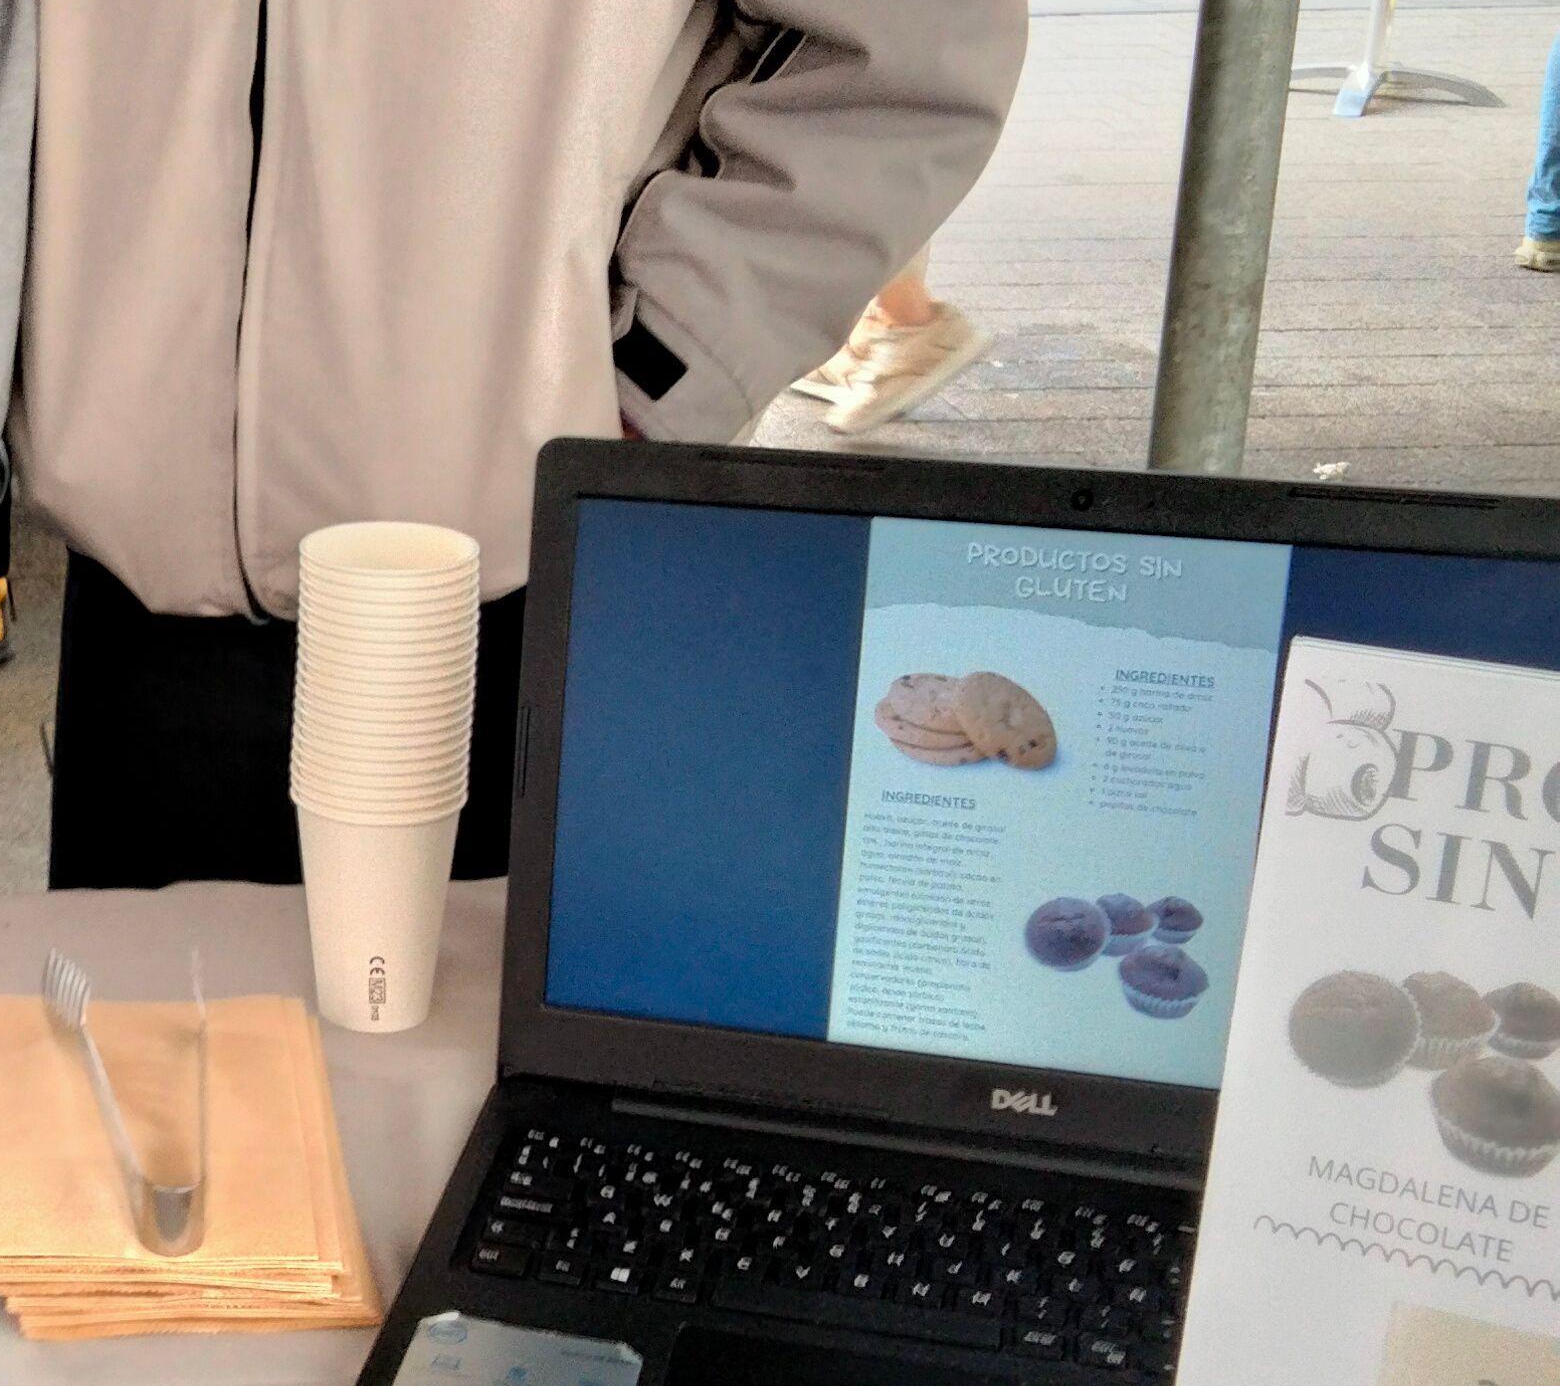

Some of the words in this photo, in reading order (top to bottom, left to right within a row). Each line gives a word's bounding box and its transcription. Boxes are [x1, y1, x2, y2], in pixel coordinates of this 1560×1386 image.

[967, 541, 1128, 574] PRODUCTOS
[1139, 554, 1182, 579] SIN
[1015, 576, 1128, 603] GLUTEN
[1115, 669, 1216, 689] INGREDIENTES
[1383, 729, 1560, 824] PR
[882, 790, 976, 810] INGREDIENTES
[1360, 823, 1556, 920] SIN
[990, 1088, 1058, 1117] DELL
[1308, 1156, 1498, 1218] MAGDALENA
[1508, 1200, 1550, 1229] DE
[1329, 1202, 1513, 1262] CHOCOLATE
